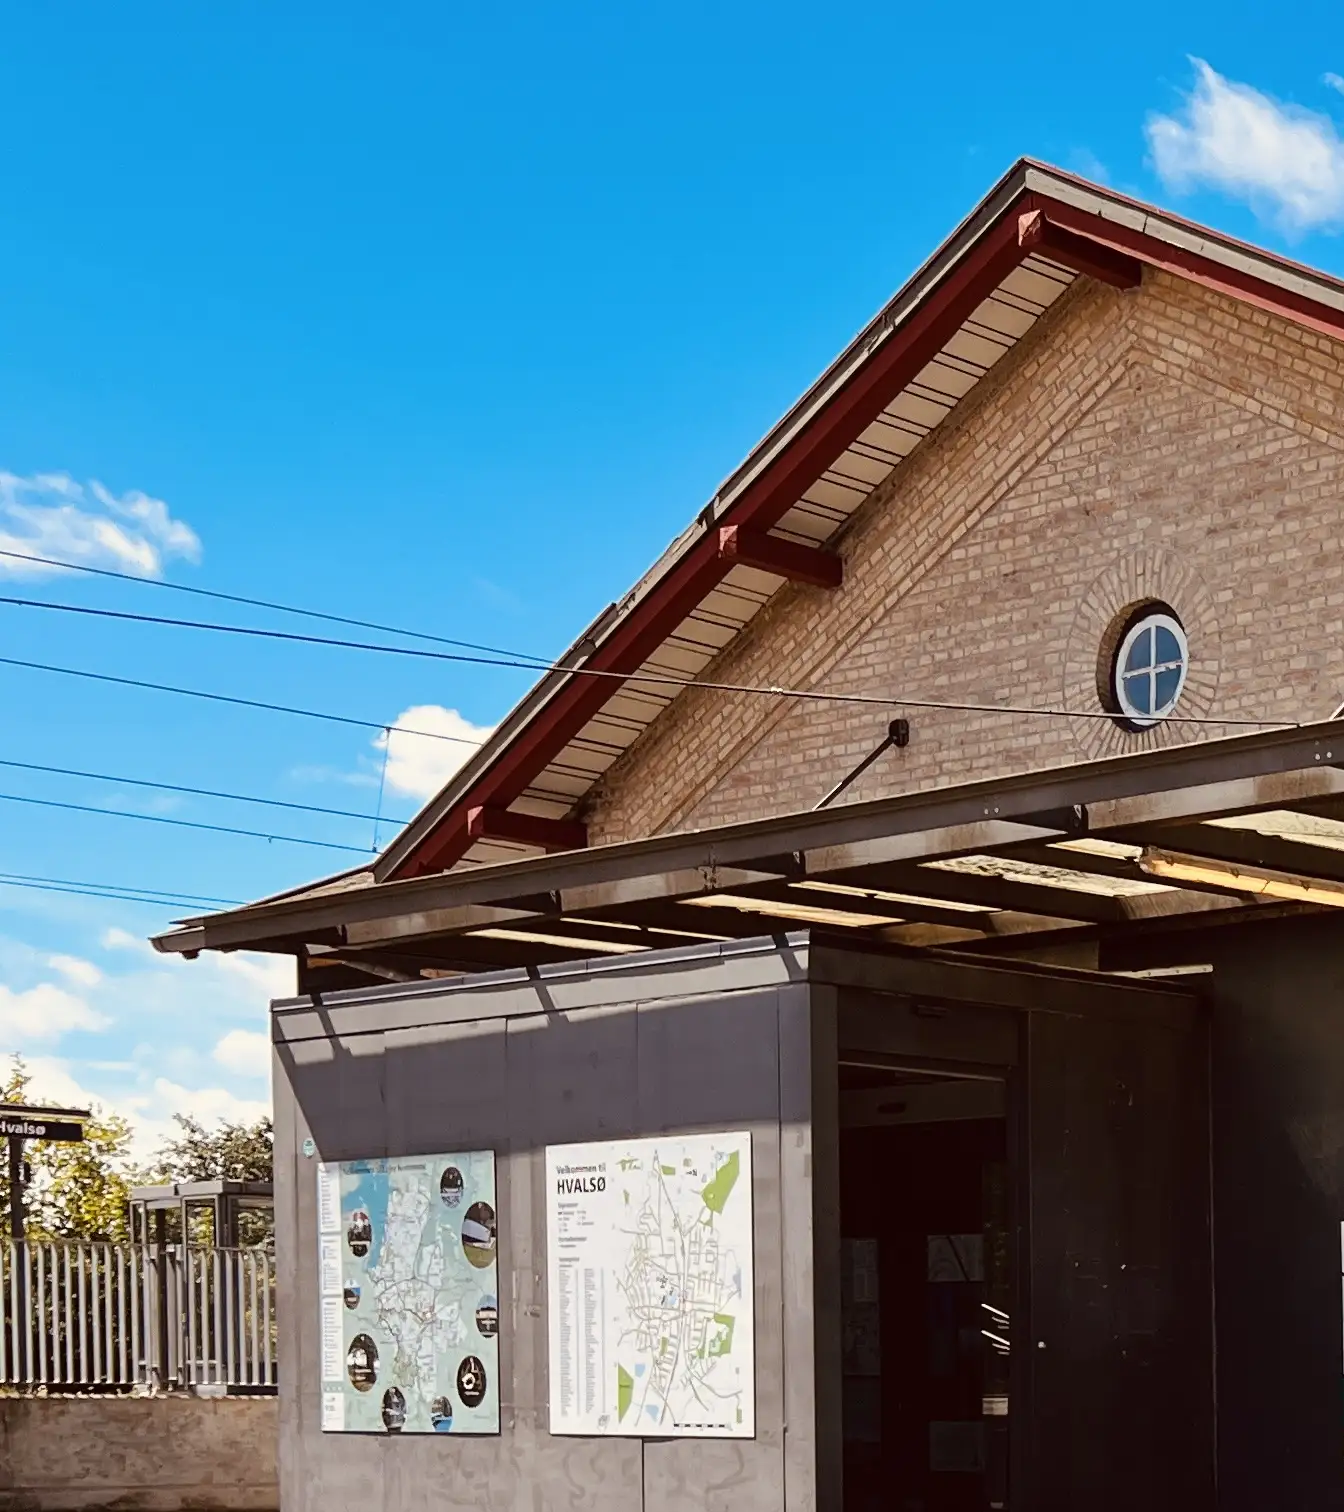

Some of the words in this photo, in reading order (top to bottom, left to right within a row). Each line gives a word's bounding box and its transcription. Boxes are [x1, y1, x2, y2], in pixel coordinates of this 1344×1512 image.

[556, 1164, 597, 1175] Velkommen
[598, 1162, 607, 1173] til
[557, 1176, 606, 1195] HVALSØ
